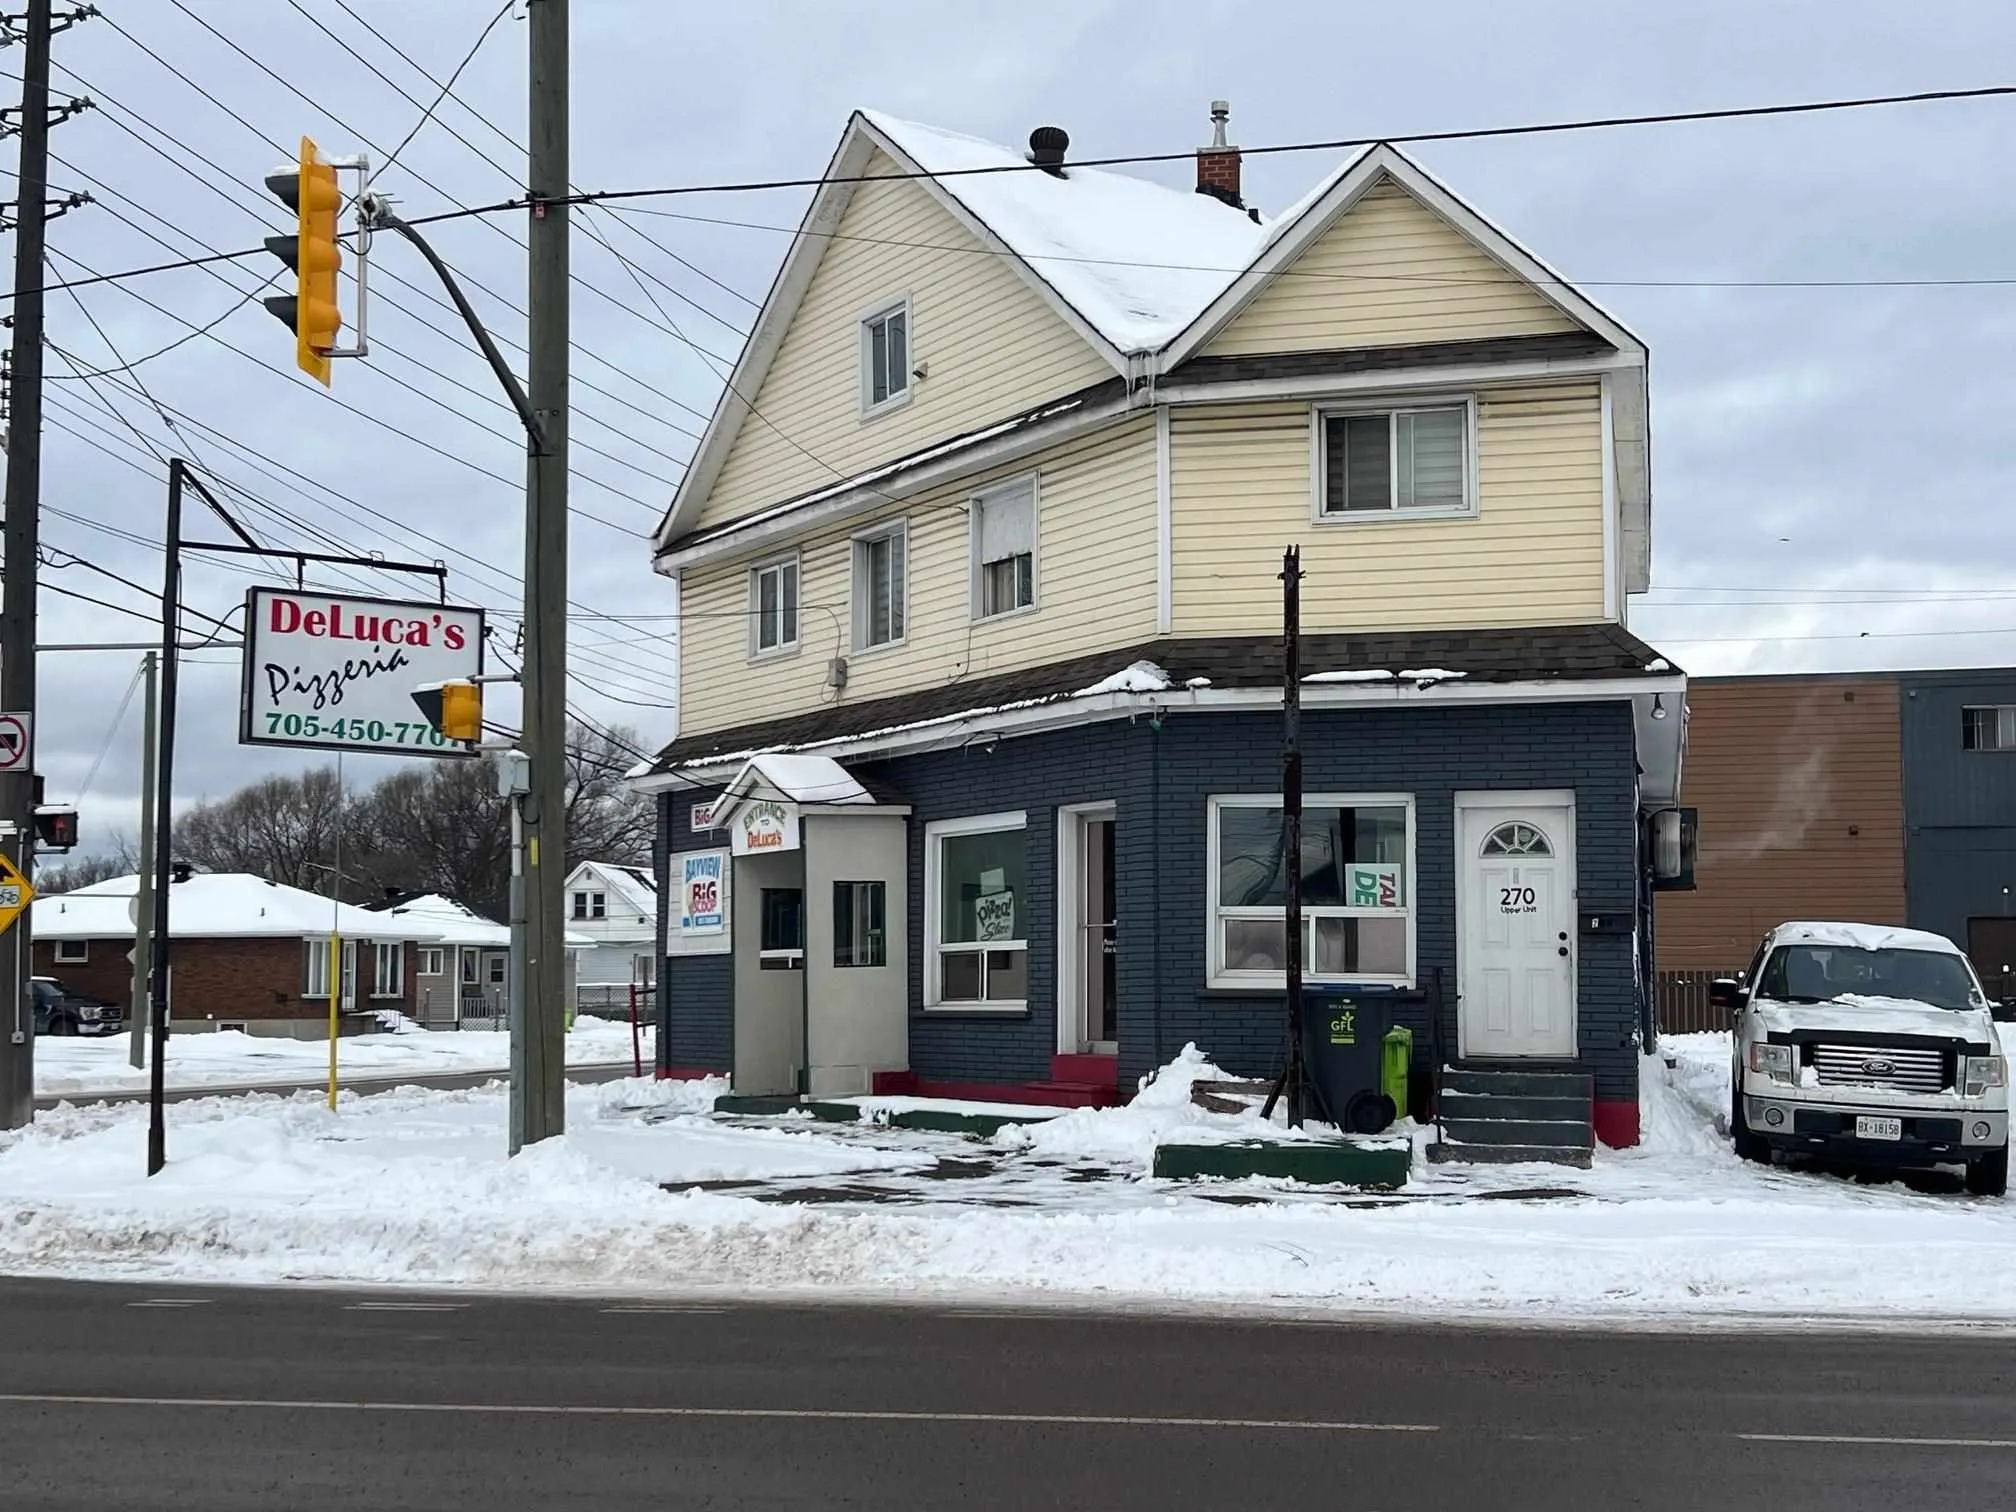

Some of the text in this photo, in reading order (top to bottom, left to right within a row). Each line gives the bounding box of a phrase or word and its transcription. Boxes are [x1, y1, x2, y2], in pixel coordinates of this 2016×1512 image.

[270, 598, 465, 649] DeLuca's
[264, 645, 409, 710] Pizzeria
[265, 712, 458, 748] 705-450-770
[744, 801, 787, 832] ENTRANCE
[686, 856, 721, 882] BAYVIEW
[694, 899, 717, 914] SCOOP
[1500, 887, 1535, 906] 270
[1500, 906, 1520, 914] Upper
[1330, 1011, 1355, 1032] GFL
